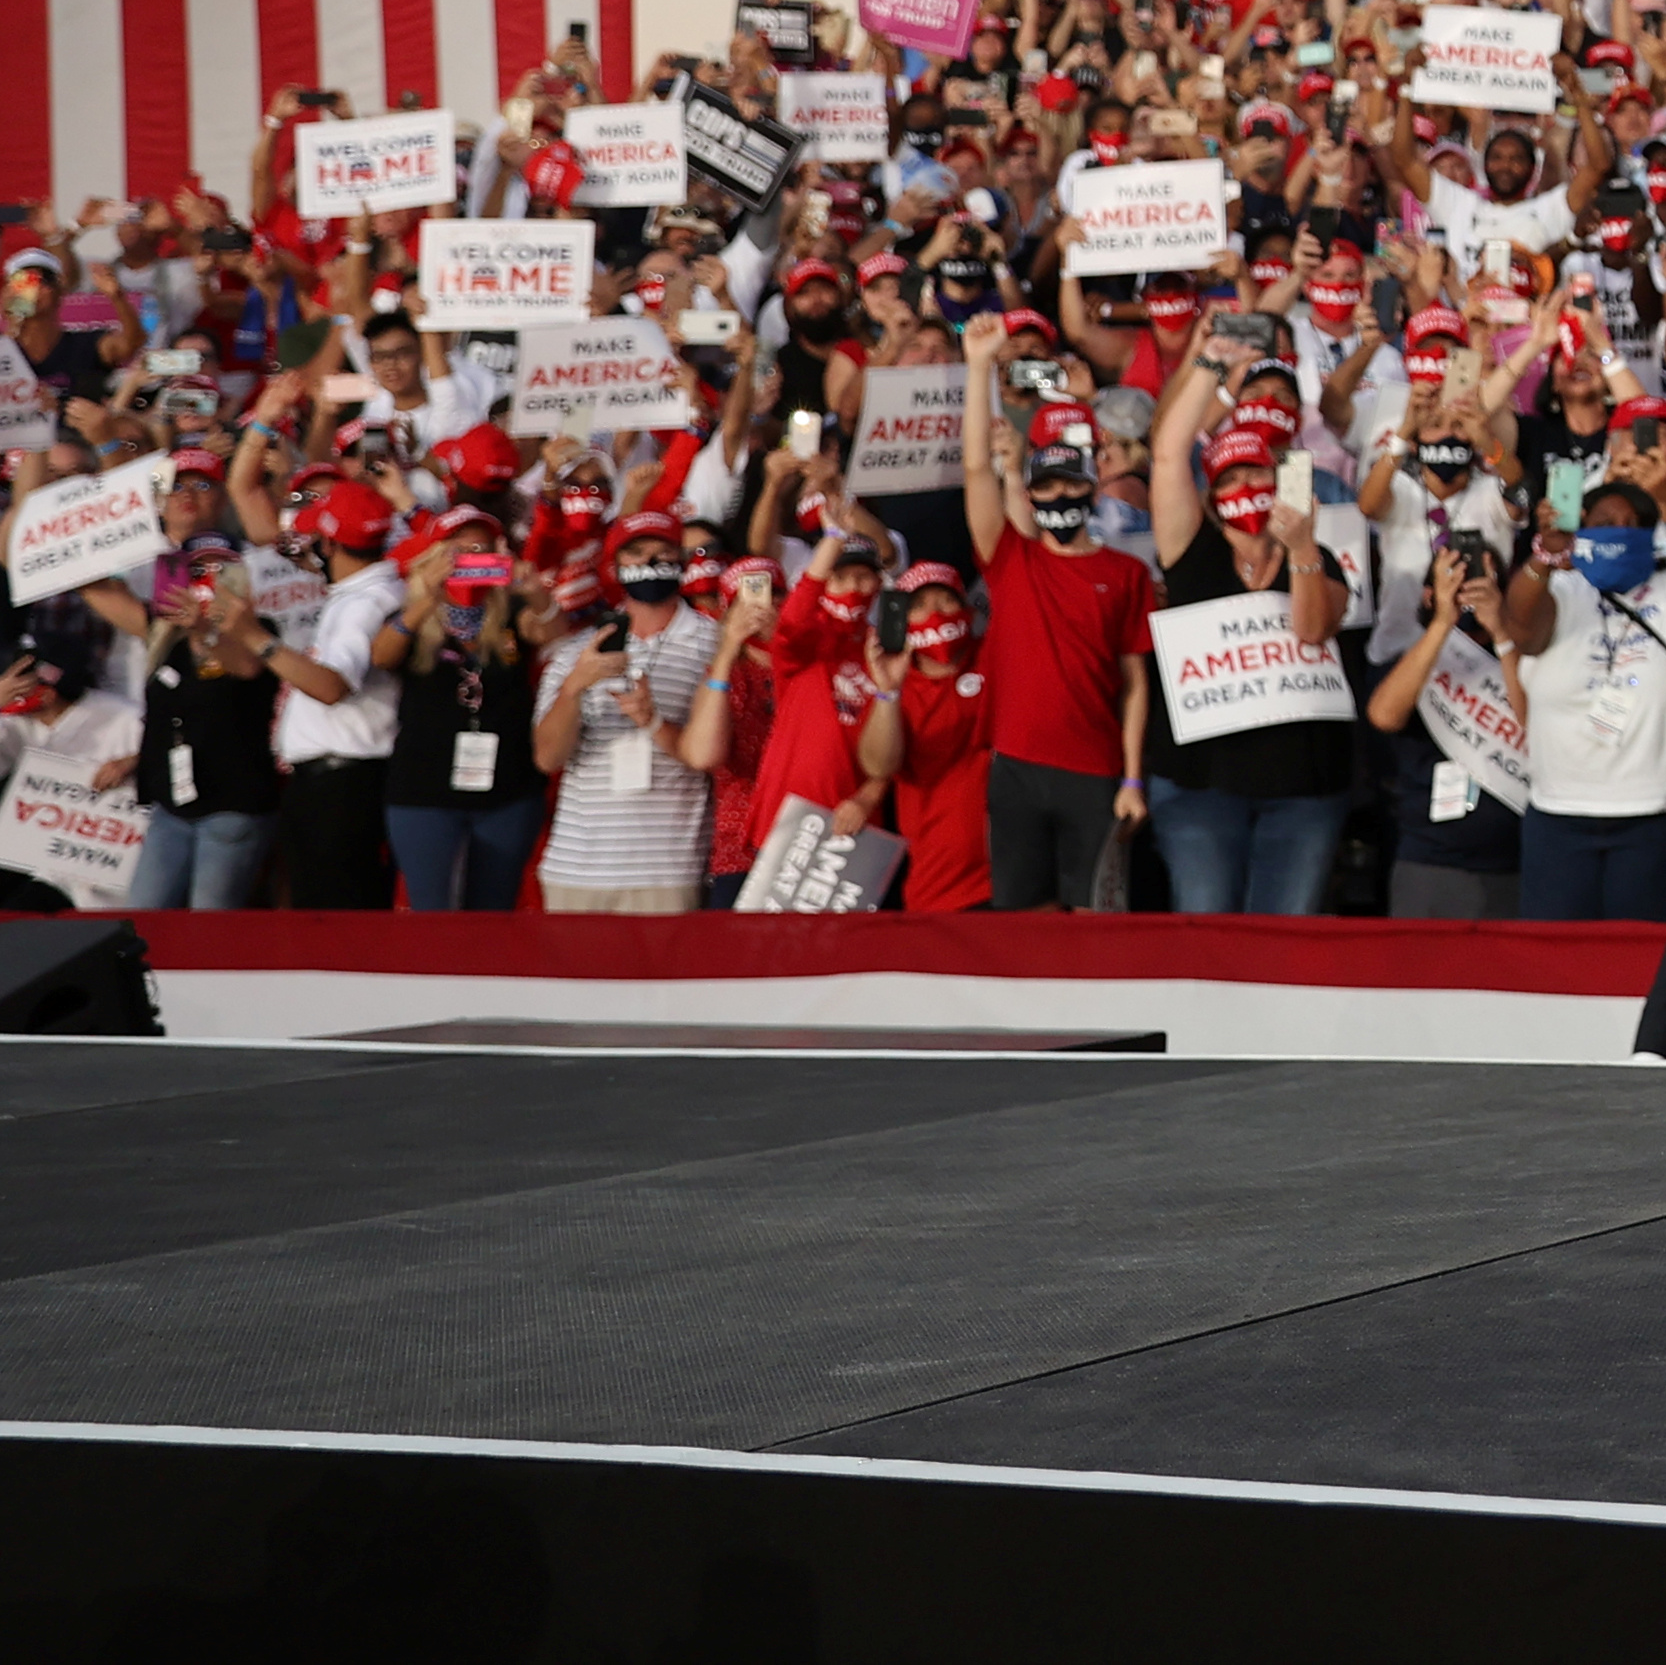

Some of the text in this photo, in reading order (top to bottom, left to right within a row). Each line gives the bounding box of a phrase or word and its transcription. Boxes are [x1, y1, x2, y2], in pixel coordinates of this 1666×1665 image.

[1464, 26, 1515, 41] MAKE
[1426, 43, 1549, 71] AMERICA
[1424, 69, 1549, 92] GREAT AGAIN
[792, 105, 889, 125] AMERIC
[596, 122, 645, 137] MAKE
[317, 133, 437, 157] WELCOME
[1116, 182, 1175, 198] MAKE
[1082, 199, 1216, 229] AMERICA
[1153, 228, 1217, 246] AGAIN
[448, 243, 573, 262] WELCOME
[571, 338, 636, 356] MAKE
[528, 356, 680, 389] AMERICA
[1407, 355, 1447, 374] MAG
[607, 385, 680, 406] AGAIN
[867, 416, 963, 443] AMERI
[860, 448, 930, 470] GREAT
[1216, 492, 1275, 522] MAG
[19, 490, 145, 551] AMERICA
[20, 521, 151, 577] GREAT AGAIN
[1220, 616, 1293, 640] MAKE
[1178, 640, 1338, 685] AMERICA
[1181, 672, 1345, 712] GREAT AGAIN
[1434, 670, 1529, 758] AMERI
[1488, 748, 1531, 790] AGA
[14, 794, 146, 847] MERICA
[48, 836, 123, 871] MAKE
